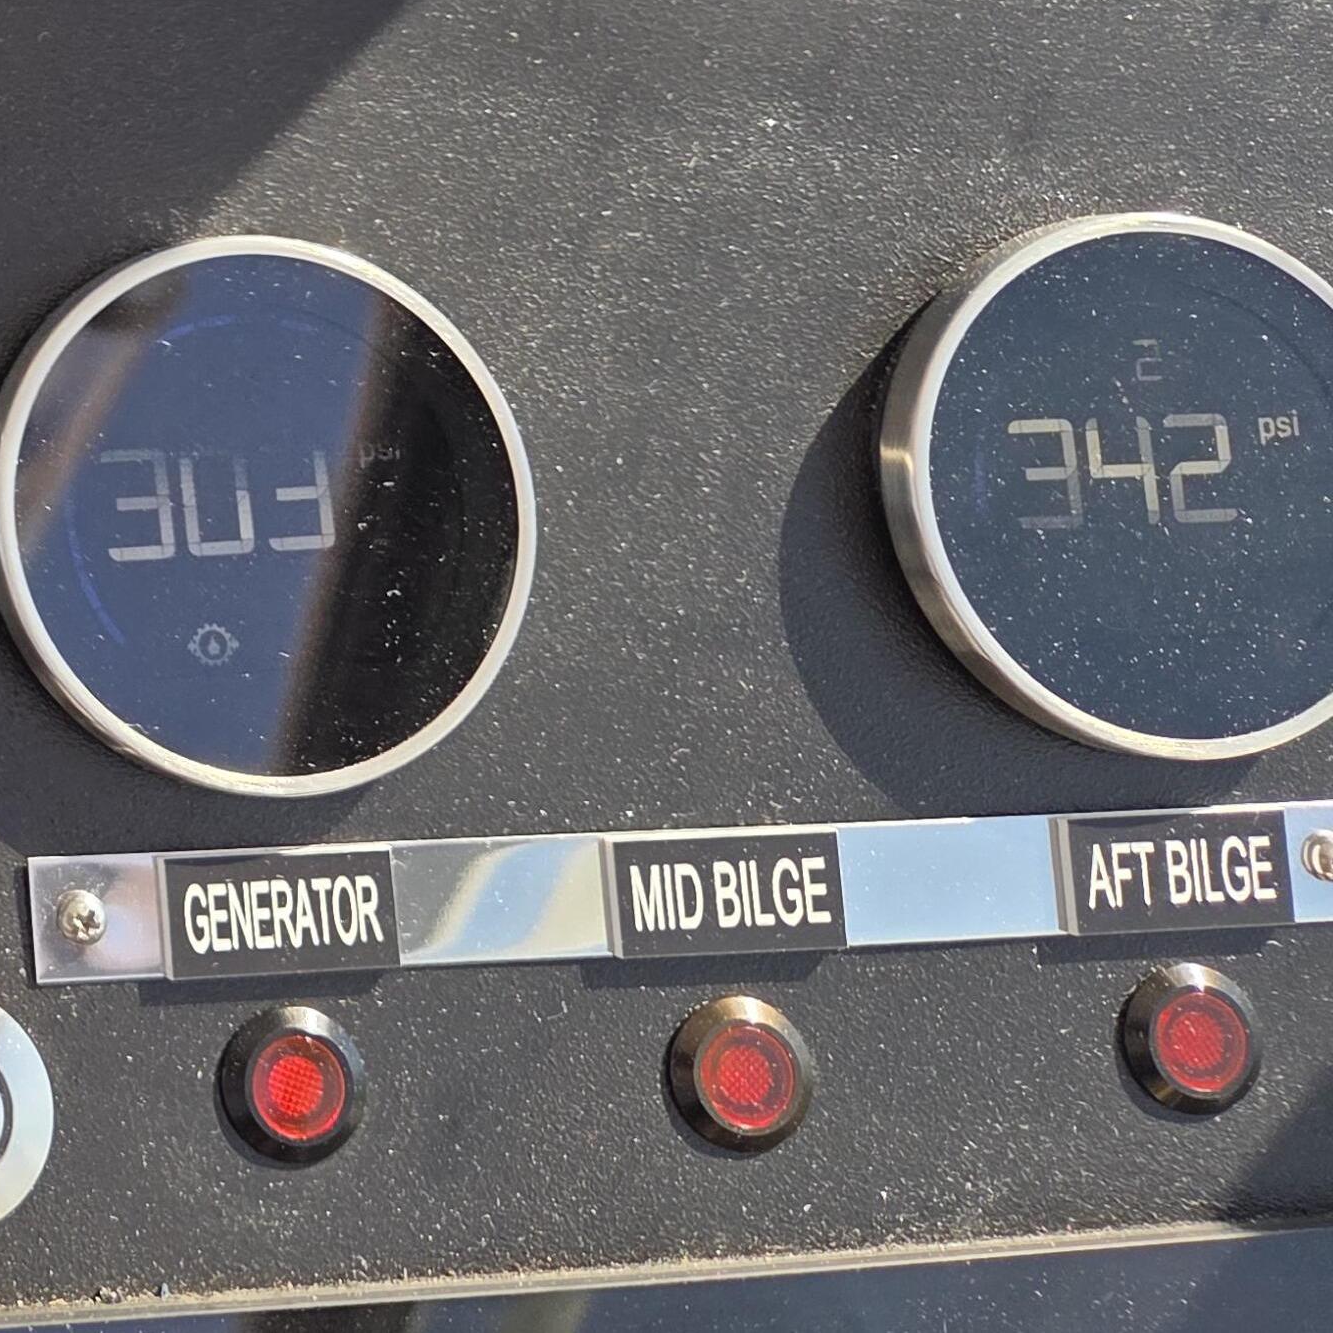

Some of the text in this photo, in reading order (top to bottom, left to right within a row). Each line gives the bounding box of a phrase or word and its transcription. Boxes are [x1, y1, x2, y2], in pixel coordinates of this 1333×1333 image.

[1007, 410, 1301, 529] 342 psi
[629, 856, 831, 932] MID BILGE
[1087, 834, 1277, 909] AFT BILGE
[183, 873, 384, 955] GENERATOR
